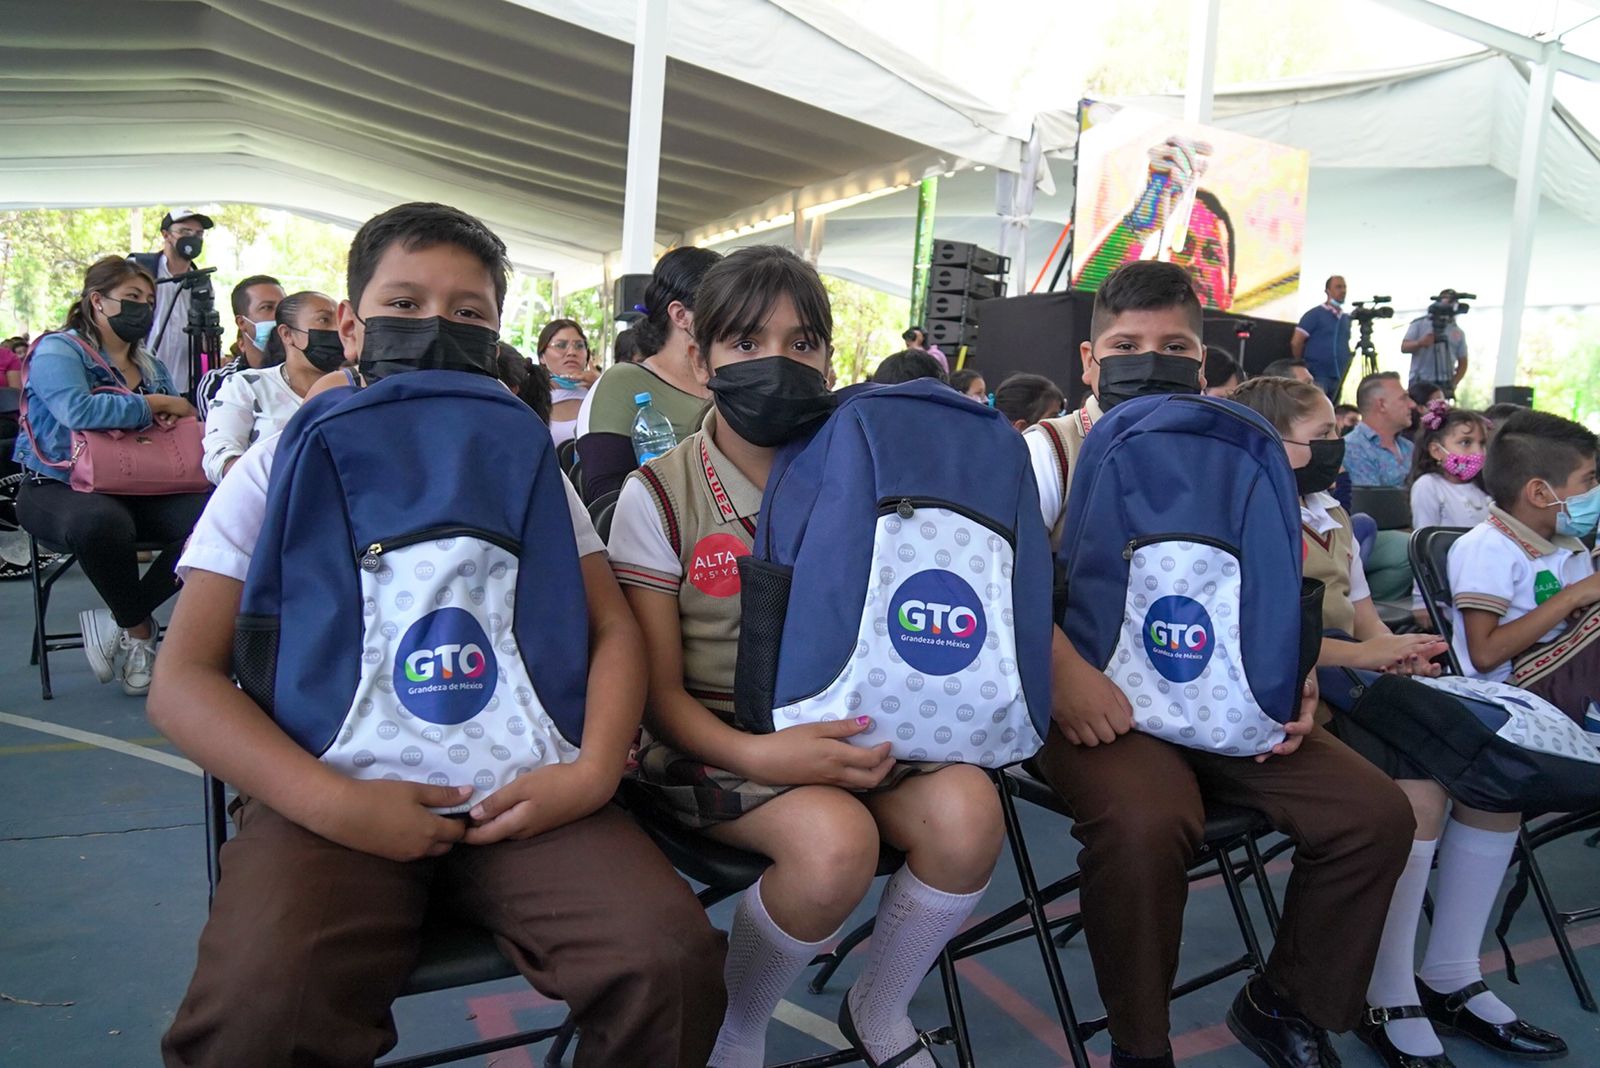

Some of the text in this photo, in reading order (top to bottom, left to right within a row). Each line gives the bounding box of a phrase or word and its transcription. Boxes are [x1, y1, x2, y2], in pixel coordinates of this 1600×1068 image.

[701, 440, 733, 515] RQUEZ
[921, 526, 936, 535] GTO
[955, 532, 969, 540] GTO
[900, 548, 915, 557] GTO
[695, 550, 737, 570] ALTA
[935, 554, 950, 562] GTO
[970, 560, 984, 568] GTO
[415, 566, 434, 575] GTO
[722, 568, 729, 576] Y
[898, 599, 978, 638] GTO
[1151, 620, 1207, 651] GTO
[900, 634, 935, 645] Grandeza
[945, 639, 970, 649] México
[405, 643, 486, 682] GTO
[869, 673, 885, 681] GTO
[907, 677, 924, 686] GTO
[408, 681, 484, 695] Grandeza de México
[944, 681, 961, 690] GTO
[982, 686, 998, 694] GTO
[882, 700, 899, 709] GTO
[920, 703, 936, 712] GTO
[957, 709, 974, 717] GTO
[378, 725, 398, 733] GTO
[508, 720, 525, 729] GTO
[898, 727, 914, 735] GTO
[936, 731, 952, 739] GTO
[402, 751, 422, 760] GTO
[449, 748, 468, 757] GTO
[430, 777, 448, 785] GTO
[475, 775, 494, 783] GTO
